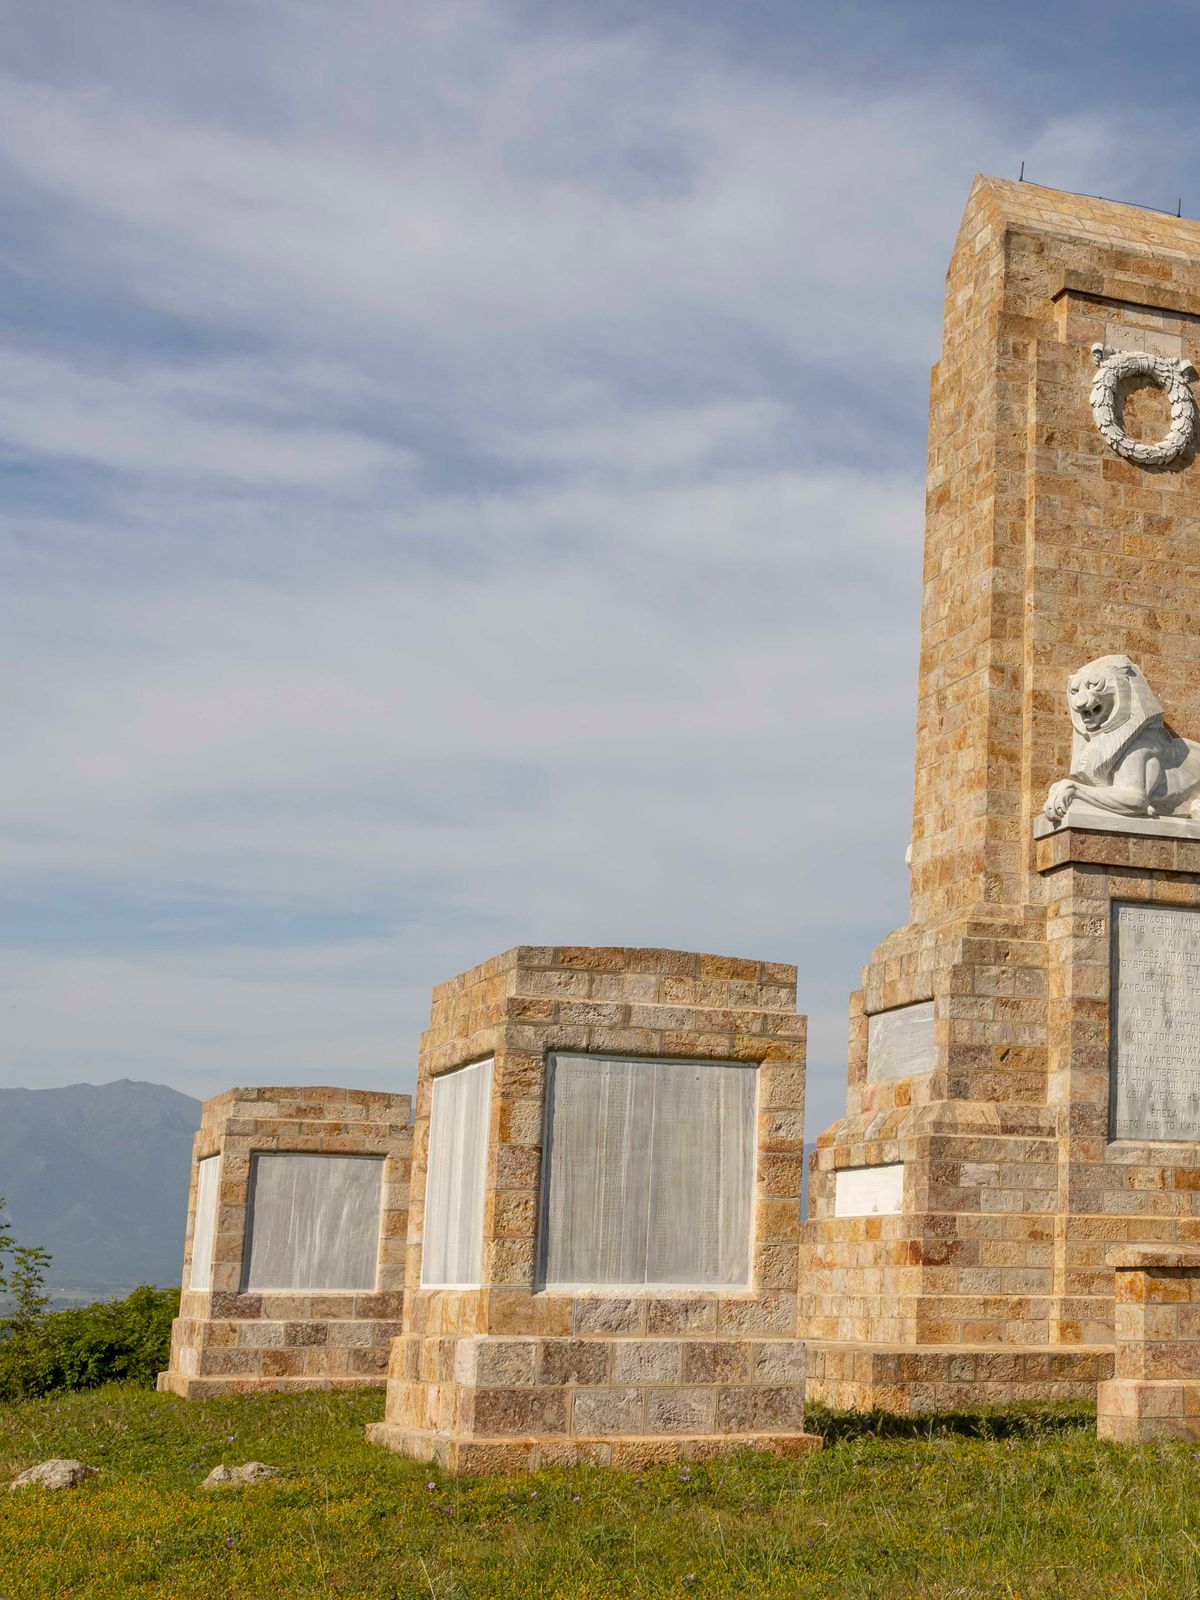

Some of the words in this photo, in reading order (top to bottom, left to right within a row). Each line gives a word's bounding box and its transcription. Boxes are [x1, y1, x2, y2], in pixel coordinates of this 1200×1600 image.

[1120, 912, 1133, 922] ΕΙΣ
[1161, 937, 1177, 948] ΚΑΙ
[1186, 976, 1198, 985] ΕΝ
[1125, 1007, 1140, 1017] ΚΑΙ
[1145, 1008, 1158, 1017] ΕΙΣ
[1154, 1032, 1170, 1042] ΤΩΝ
[1147, 1044, 1160, 1054] ΤΑ
[1135, 1066, 1151, 1077] ΤΩΝ
[1131, 1079, 1147, 1088] ΤΩΝ
[1146, 1121, 1159, 1130] ΕΙΣ
[1164, 1121, 1175, 1131] ΤΟ
